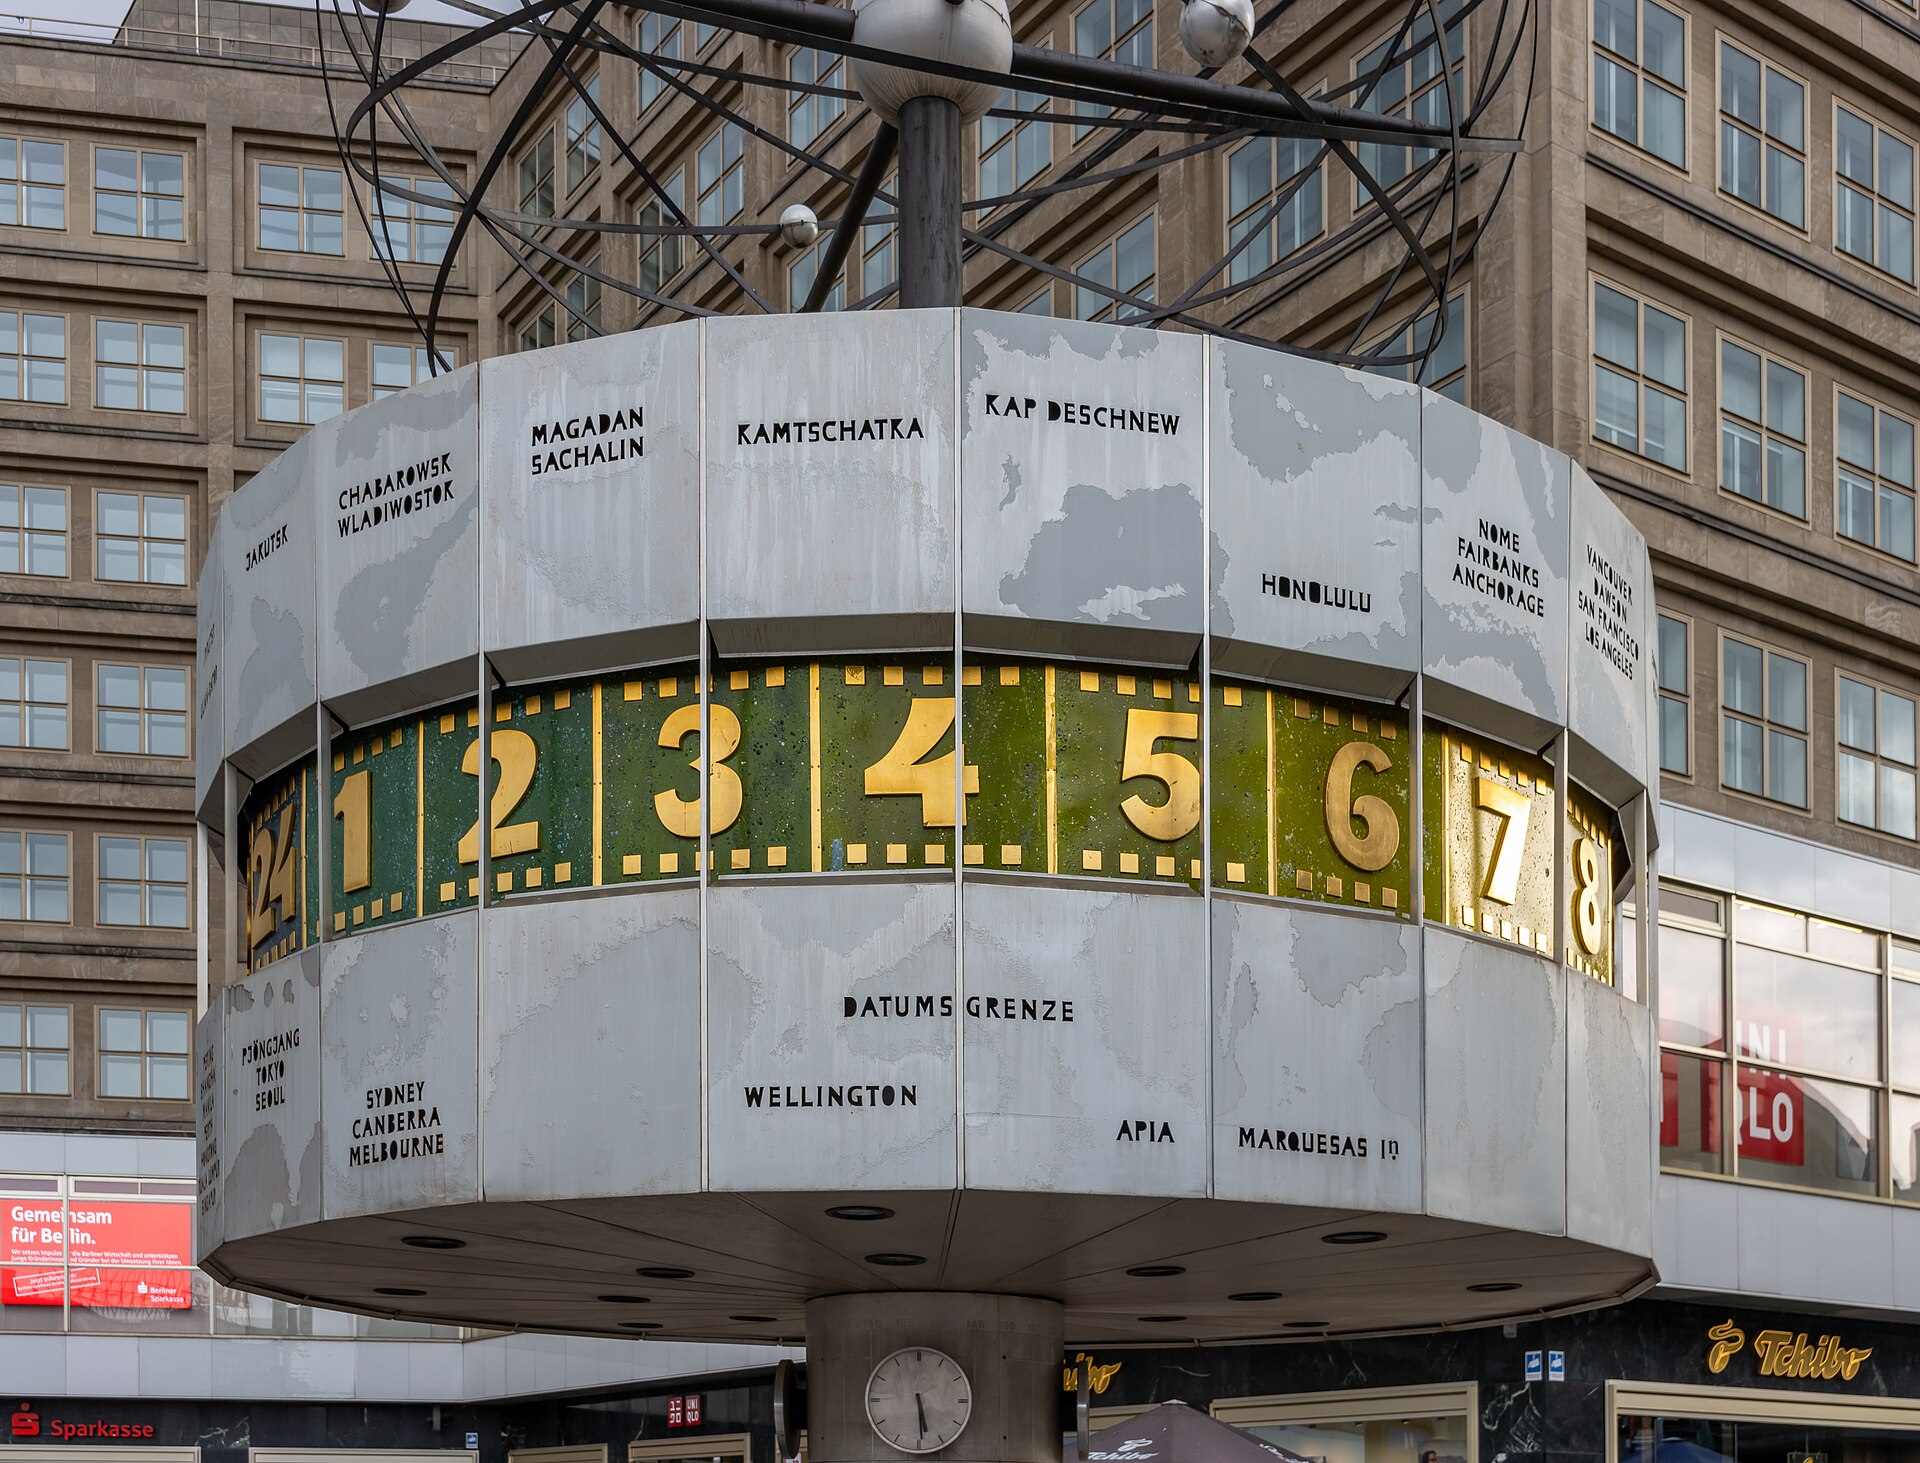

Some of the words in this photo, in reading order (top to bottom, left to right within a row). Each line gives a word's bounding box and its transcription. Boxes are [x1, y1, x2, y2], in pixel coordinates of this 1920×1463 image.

[532, 407, 644, 447] MAGADAN
[738, 418, 924, 445] KAMTSCHATKA
[985, 394, 1037, 418] KAP
[1048, 400, 1180, 435] DESCHNEW
[532, 436, 644, 475] SACHALIN
[338, 452, 452, 511] CHABAROWSK
[337, 480, 454, 538] WLADIWOSTOK
[245, 524, 289, 572] JAKUTSK
[1478, 518, 1520, 554] NOME
[1458, 537, 1539, 588] FAIRBANKS
[1586, 544, 1633, 607] VANCOUVER
[1262, 573, 1371, 613] HONOLULU
[1452, 563, 1544, 618] ANCHORAGE
[1593, 577, 1627, 625] DAWSON
[1578, 590, 1595, 619] SAN
[1598, 607, 1639, 661] FRANCISCO
[1585, 622, 1600, 650] LOS
[1601, 637, 1633, 681] ANGELES
[252, 802, 297, 949] 24
[333, 769, 371, 893] 1
[458, 729, 539, 864] 2
[654, 703, 743, 838] 3
[864, 697, 979, 828] 4
[1120, 708, 1200, 842] 5
[1324, 740, 1400, 872] 6
[1475, 776, 1531, 906] 7
[1572, 836, 1600, 955] 8
[242, 1028, 300, 1066] PJÖNGJANG
[1736, 1020, 1787, 1080] NI
[255, 1060, 285, 1087] TOKYO
[255, 1086, 285, 1112] SEOUL
[366, 1081, 425, 1110] SYDNEY
[745, 1085, 918, 1108] WELLINGTON
[352, 1107, 442, 1140] CANBERRA
[1116, 1119, 1175, 1143] APIA
[1238, 1127, 1367, 1158] MARQUESAS
[349, 1133, 444, 1168] MELBOURNE
[11, 1226, 37, 1243] für
[41, 1227, 96, 1245] Belin.
[150, 1286, 177, 1295] Berliner
[150, 1294, 184, 1303] Sparkasse
[1754, 1329, 1873, 1381] Tchibo
[687, 1398, 698, 1409] UNI
[51, 1419, 154, 1441] Sparkasse
